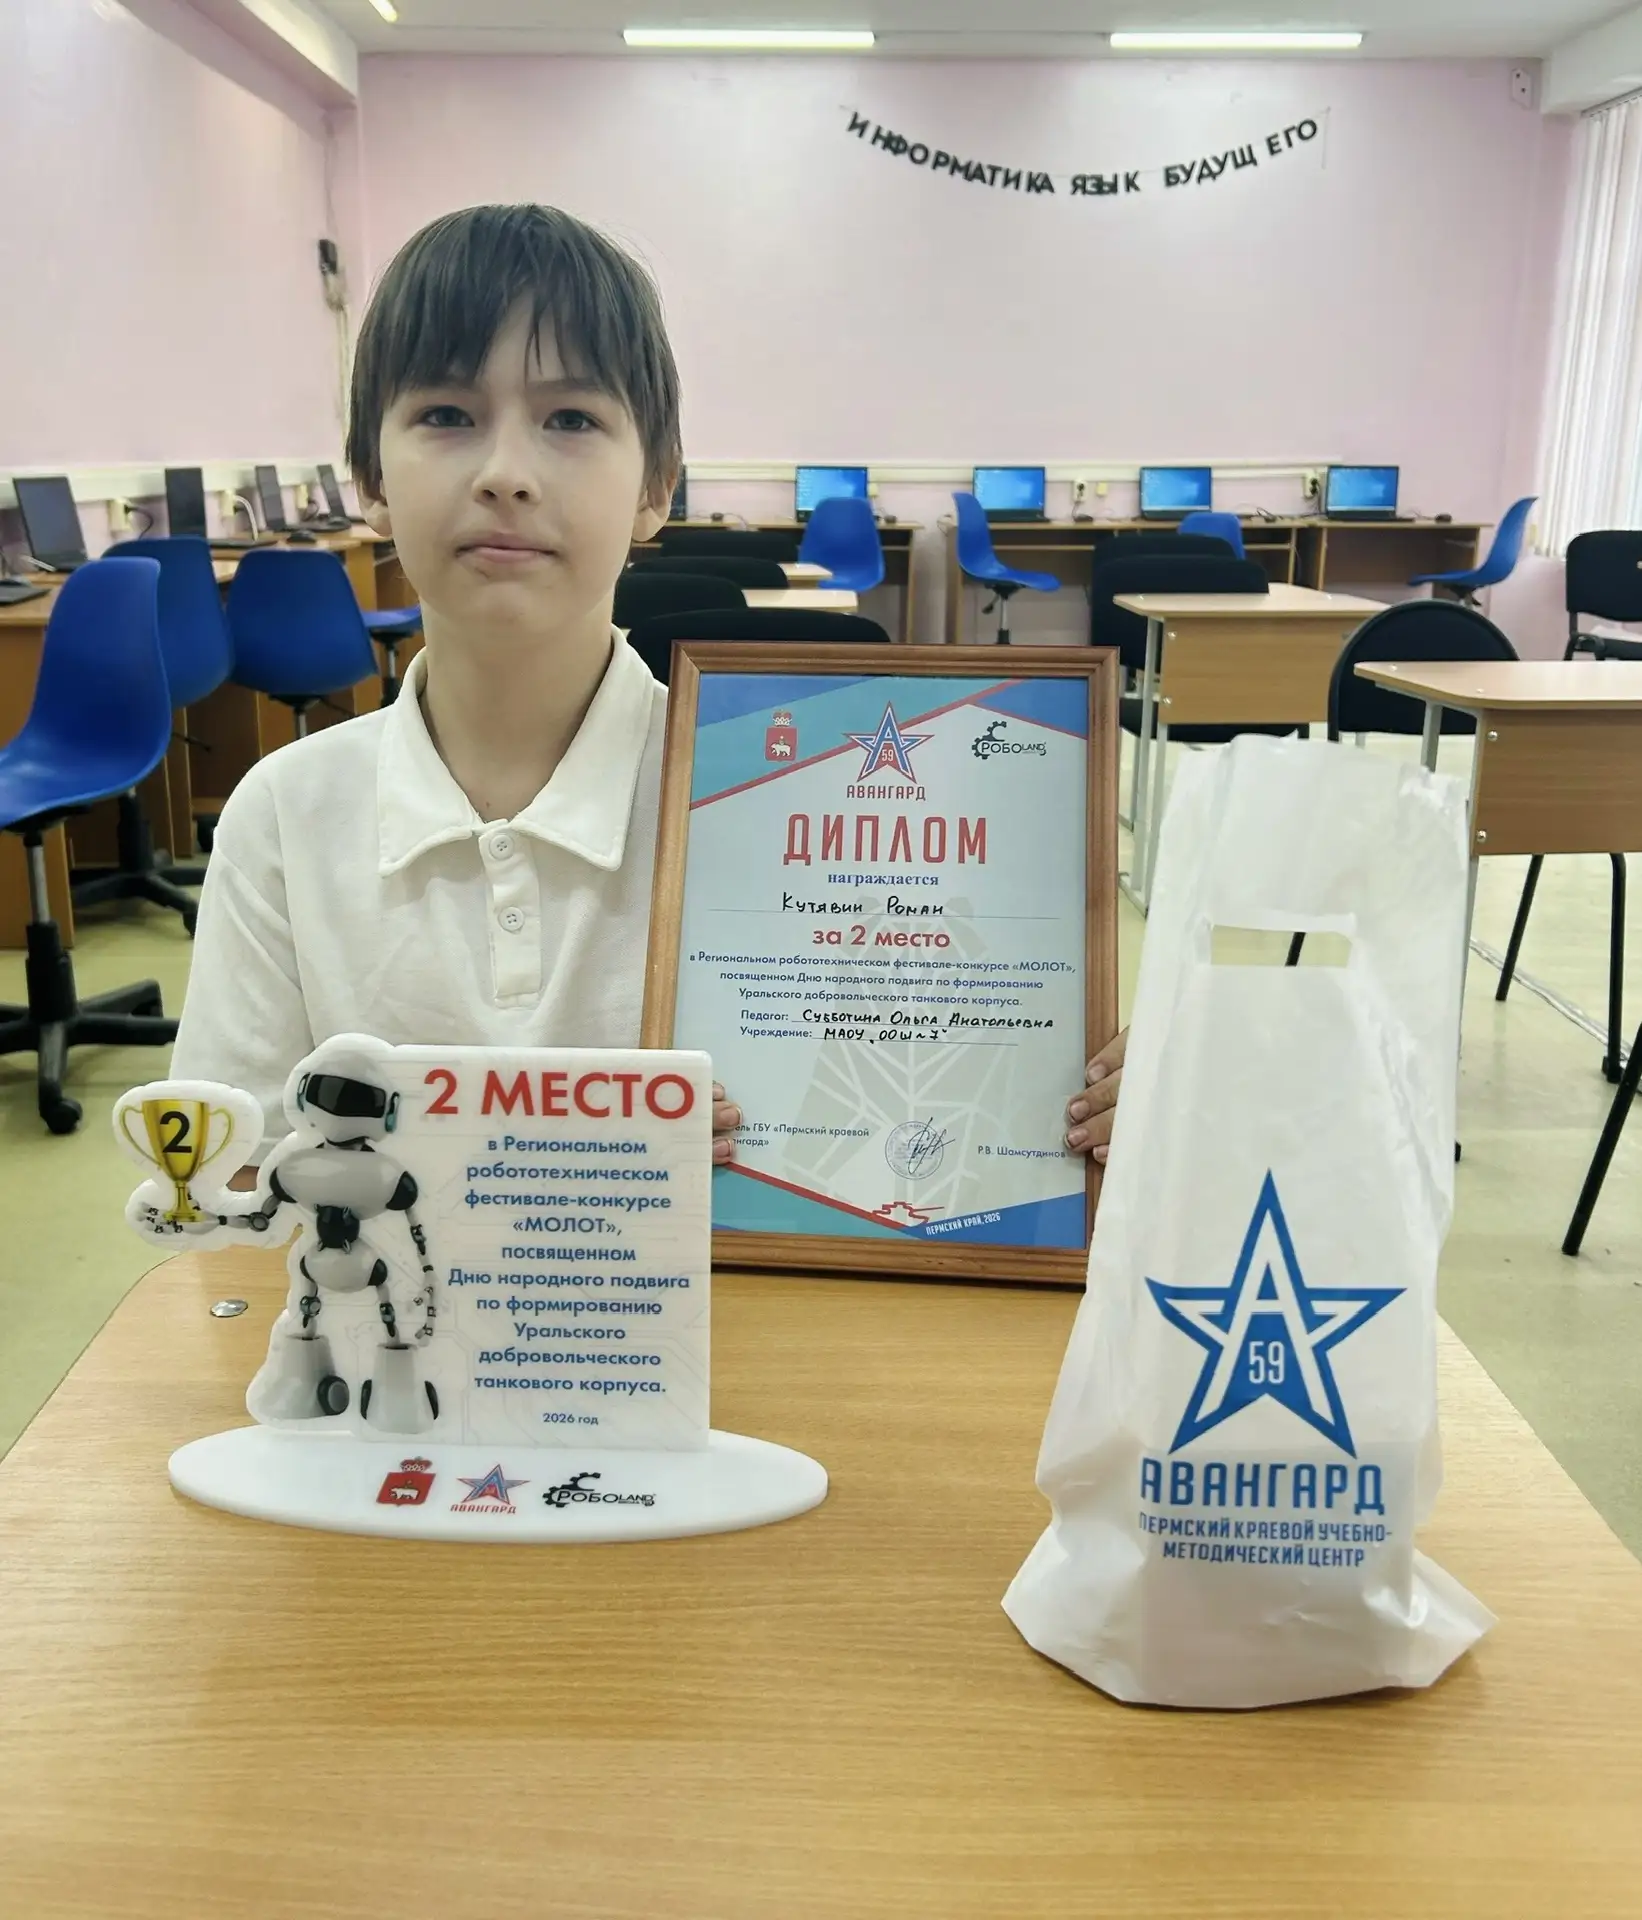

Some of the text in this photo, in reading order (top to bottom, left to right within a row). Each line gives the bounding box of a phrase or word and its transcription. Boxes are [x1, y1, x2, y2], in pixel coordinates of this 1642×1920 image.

[1070, 172, 1142, 196] ЯЗЫК
[881, 749, 894, 762] 59
[846, 785, 926, 801] АВАНГАРД
[783, 813, 988, 866] ДИПЛОМ
[827, 872, 939, 886] награждается
[782, 891, 944, 917] Кутявин Роман
[813, 924, 951, 948] за 2 место
[698, 951, 776, 964] Региональном
[778, 953, 891, 968] робототехническом
[893, 957, 1009, 972] фестивале-конкурсе
[1012, 961, 1076, 973] «МОЛОТ»,
[719, 971, 1043, 990] посвященном Дню народного подвига по формированию
[738, 988, 1023, 1008] Уральского добровольческого танкового корпуса.
[740, 1009, 789, 1021] Педагог:
[740, 1026, 813, 1039] Учреждение:
[823, 1027, 865, 1041] МАОУ
[423, 1068, 695, 1119] 2 МЕСТО
[159, 1110, 193, 1153] 2
[752, 1123, 771, 1133] ГБУ
[773, 1123, 827, 1136] «Пермский
[828, 1126, 870, 1138] краевой
[487, 1136, 647, 1153] в Региональном
[997, 1146, 1066, 1158] Шамсутдинов
[466, 1162, 669, 1181] робототехническом
[464, 1189, 672, 1212] фестивале-конкурсе
[512, 1217, 623, 1236] «МОЛОТ»,
[925, 1220, 964, 1236] ПЕРМСКИЙ
[501, 1246, 636, 1262] посвященном
[448, 1268, 690, 1290] Дню народного подвига
[476, 1296, 663, 1318] по формированию
[513, 1322, 626, 1342] Уральского
[479, 1346, 661, 1366] добровольческого
[1248, 1340, 1285, 1384] 59
[474, 1376, 667, 1396] танкового корпуса.
[542, 1412, 599, 1426] 2026 год
[1140, 1457, 1386, 1516] АВАНГАРД
[450, 1503, 517, 1515] АВАНГАРД
[1139, 1511, 1393, 1543] ПЕРМСКИЙ КРАЕВОЙ УЧЕБНО-
[1162, 1540, 1365, 1568] МЕТОДИЧЕСКИЙ ЦЕНТР
